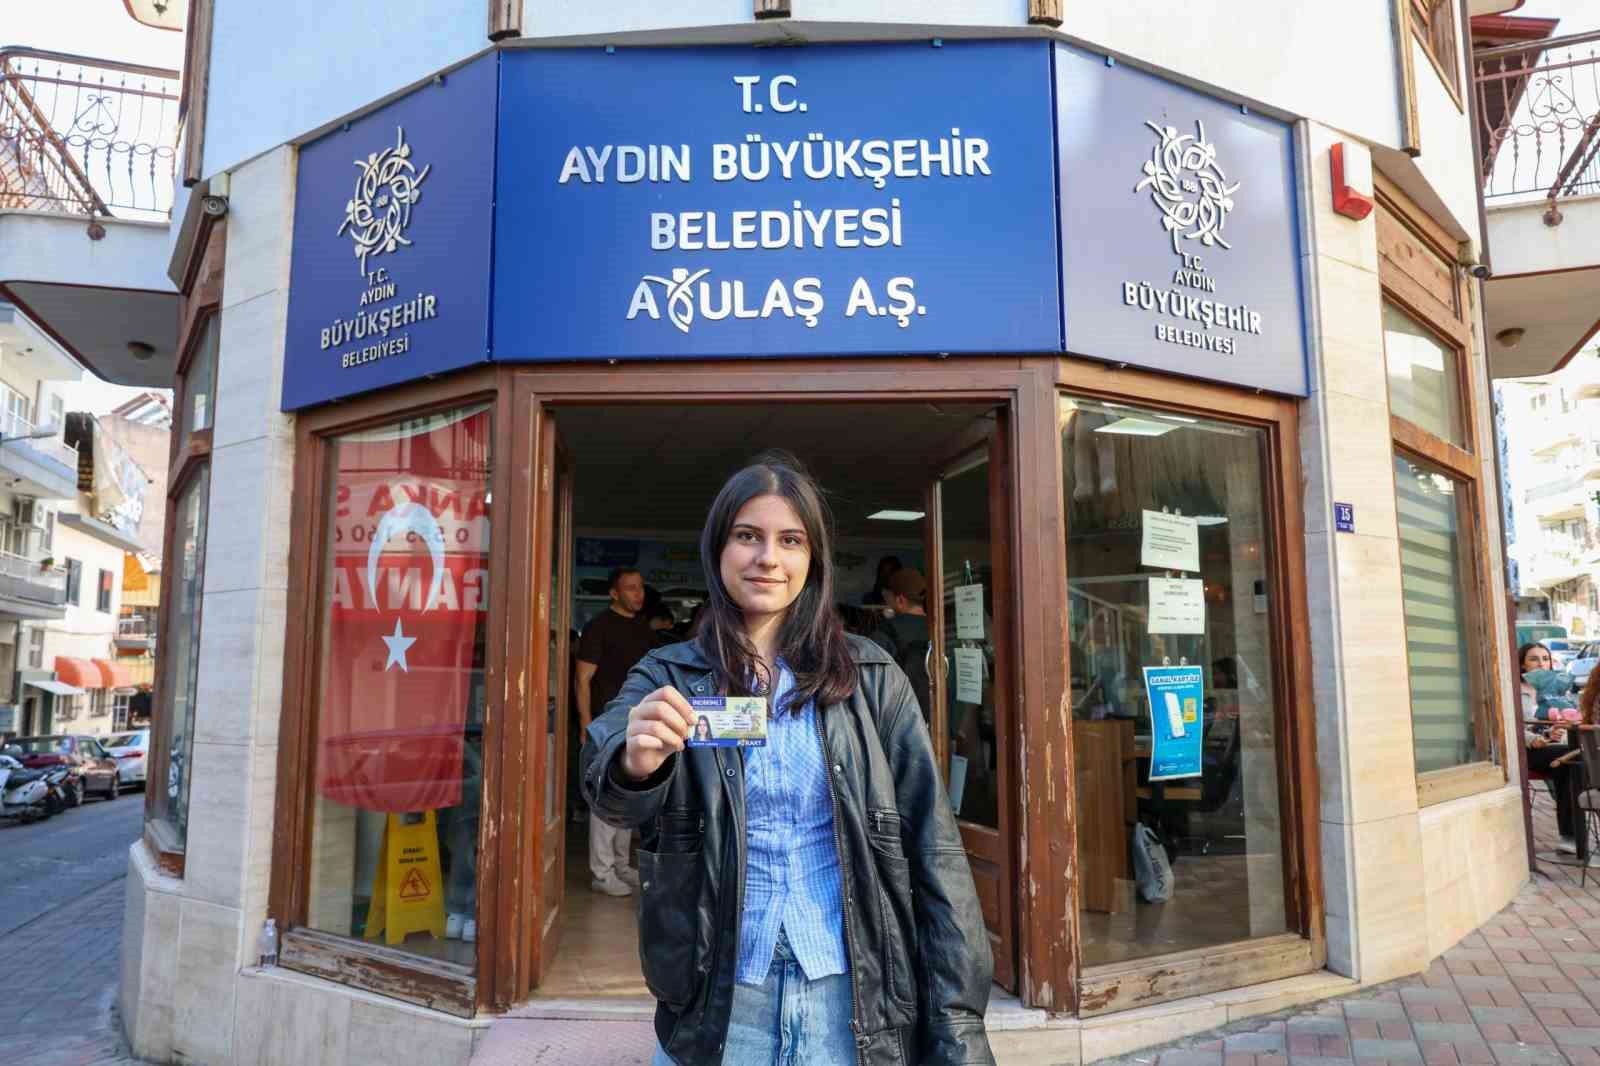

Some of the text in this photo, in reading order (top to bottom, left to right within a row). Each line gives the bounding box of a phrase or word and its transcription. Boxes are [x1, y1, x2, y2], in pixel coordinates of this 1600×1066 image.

[734, 75, 808, 113] T.C.
[558, 127, 992, 189] AYDIN BÜYÜKŞEHİR
[650, 198, 903, 250] BELEDİYESİ
[368, 267, 388, 286] T.C.
[1183, 253, 1206, 271] T.C.
[360, 283, 395, 306] AYDIN
[1174, 270, 1216, 293] AYDIN
[320, 293, 436, 350] BÜYÜKŞEHİR
[845, 277, 927, 329] A.Ş.
[1123, 281, 1262, 335] BÜYÜKŞEHİR
[342, 332, 408, 368] BELEDİYESİ
